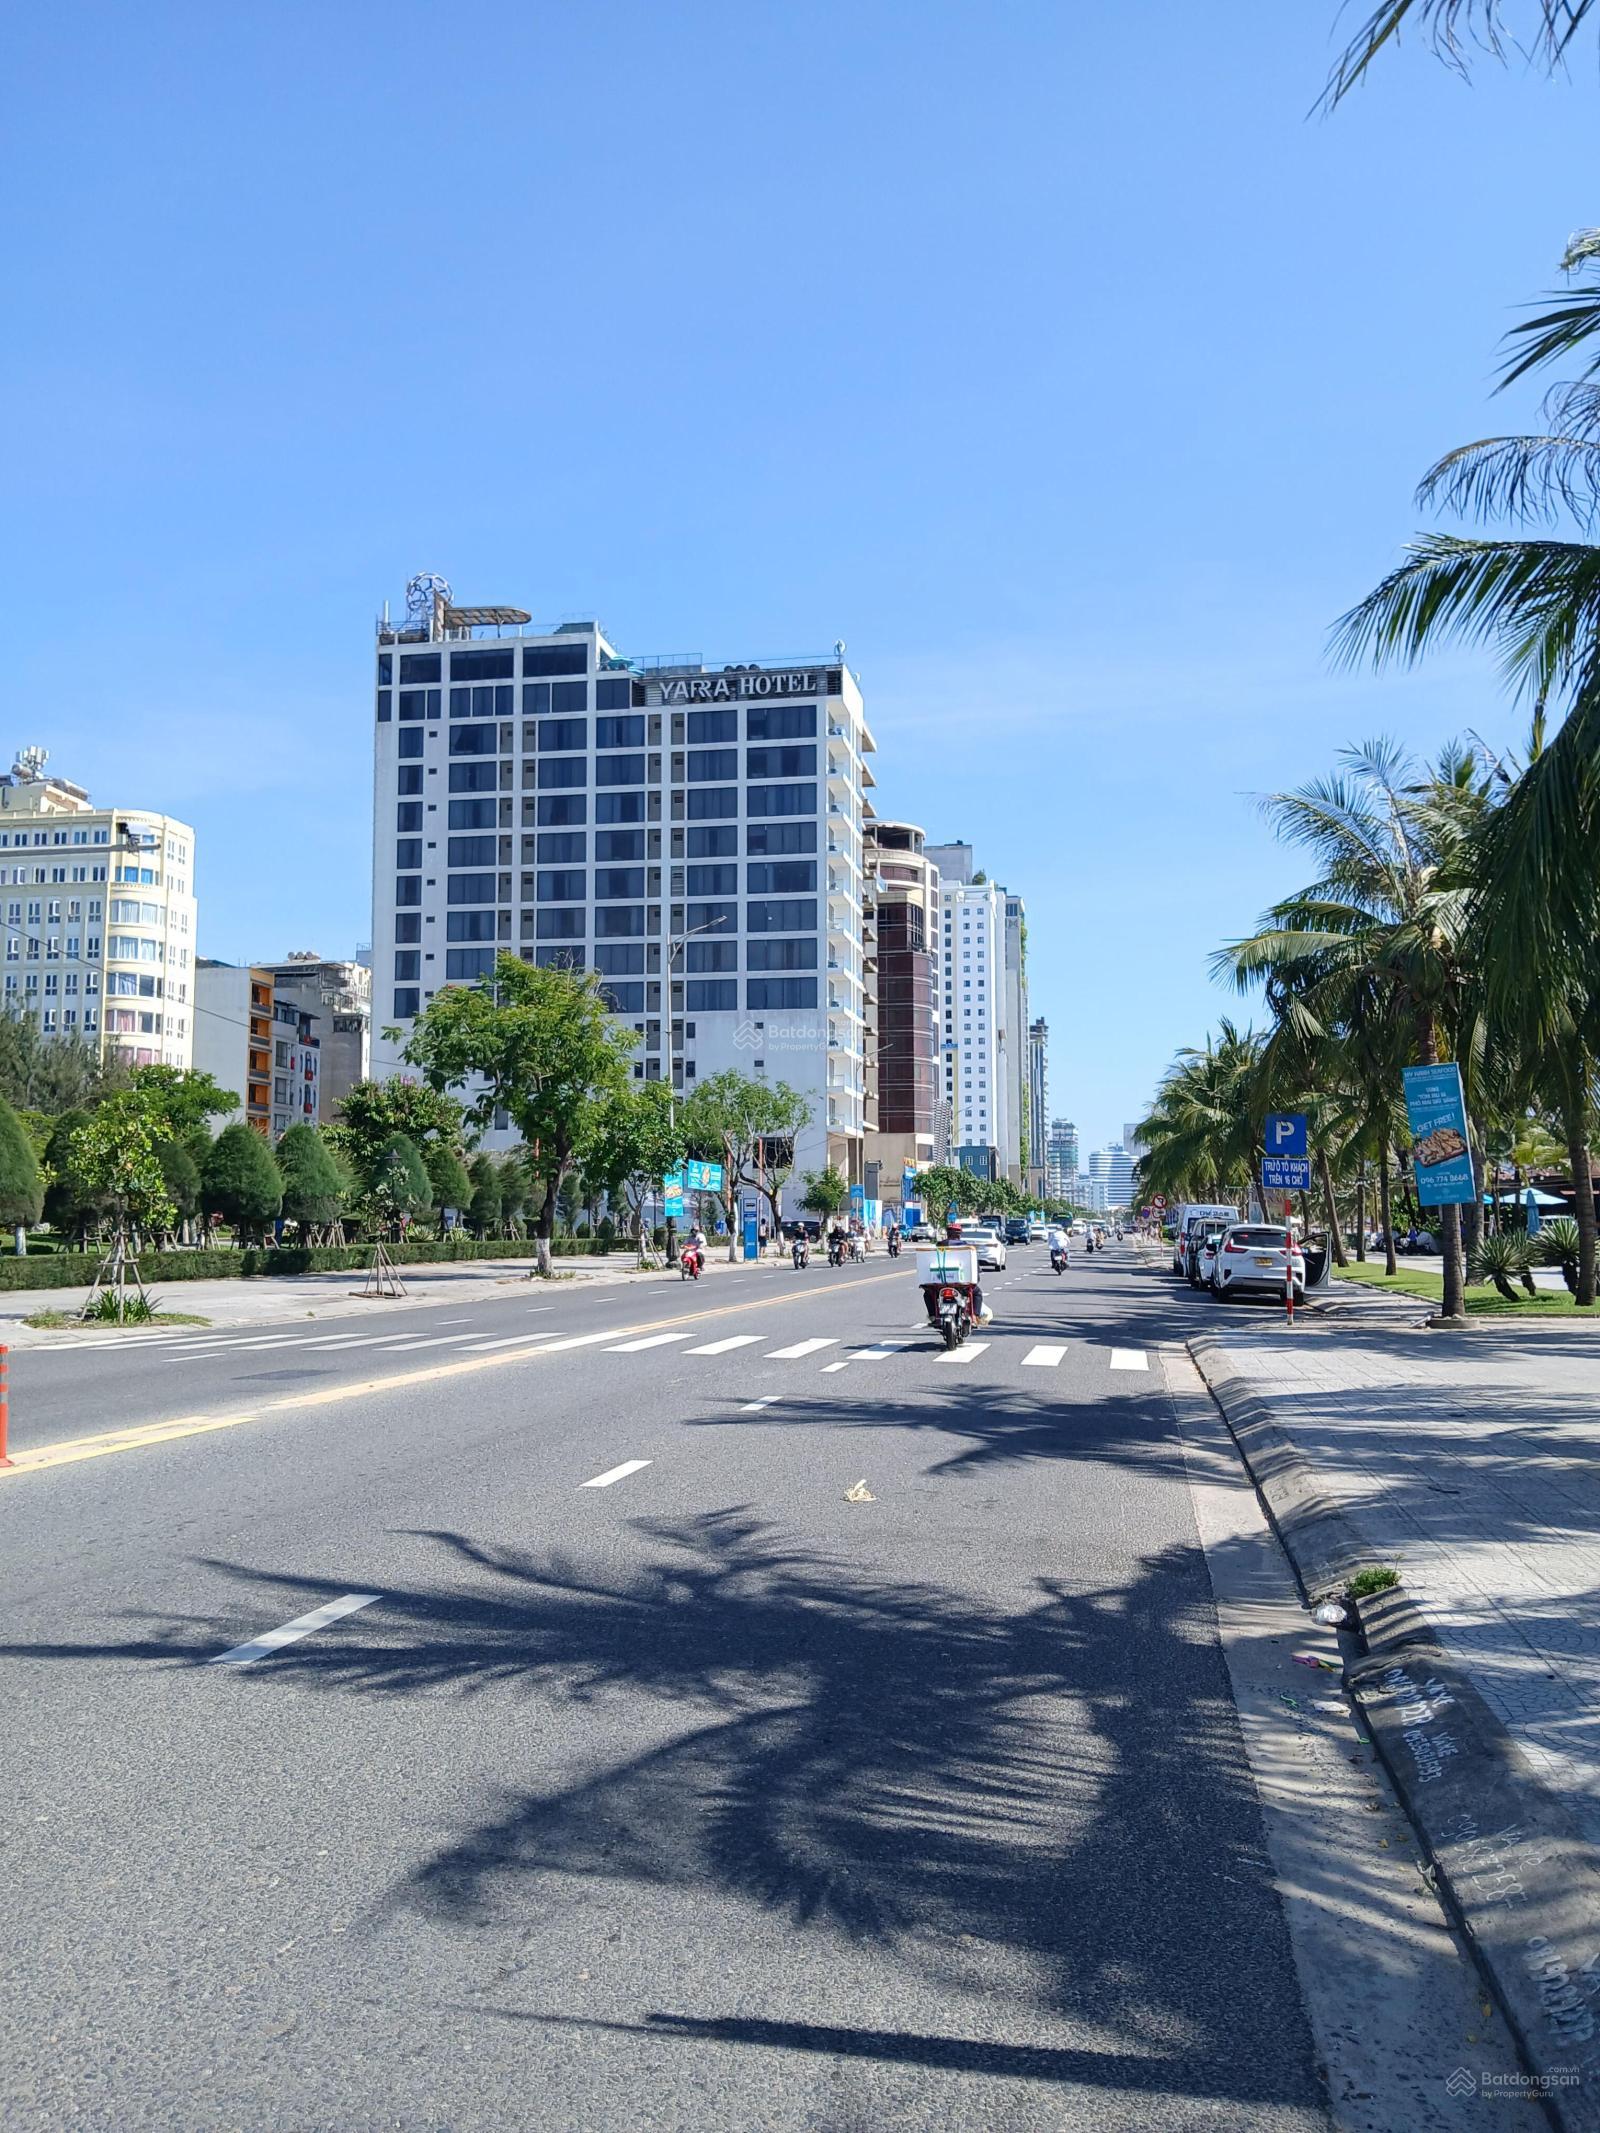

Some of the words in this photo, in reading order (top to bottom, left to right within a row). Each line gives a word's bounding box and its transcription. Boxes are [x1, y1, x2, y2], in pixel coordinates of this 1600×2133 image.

[659, 678, 730, 700] YARRA
[740, 672, 816, 696] HOTEL
[1276, 1121, 1295, 1145] P
[1417, 1121, 1432, 1132] GET
[1434, 1111, 1455, 1127] FREE!
